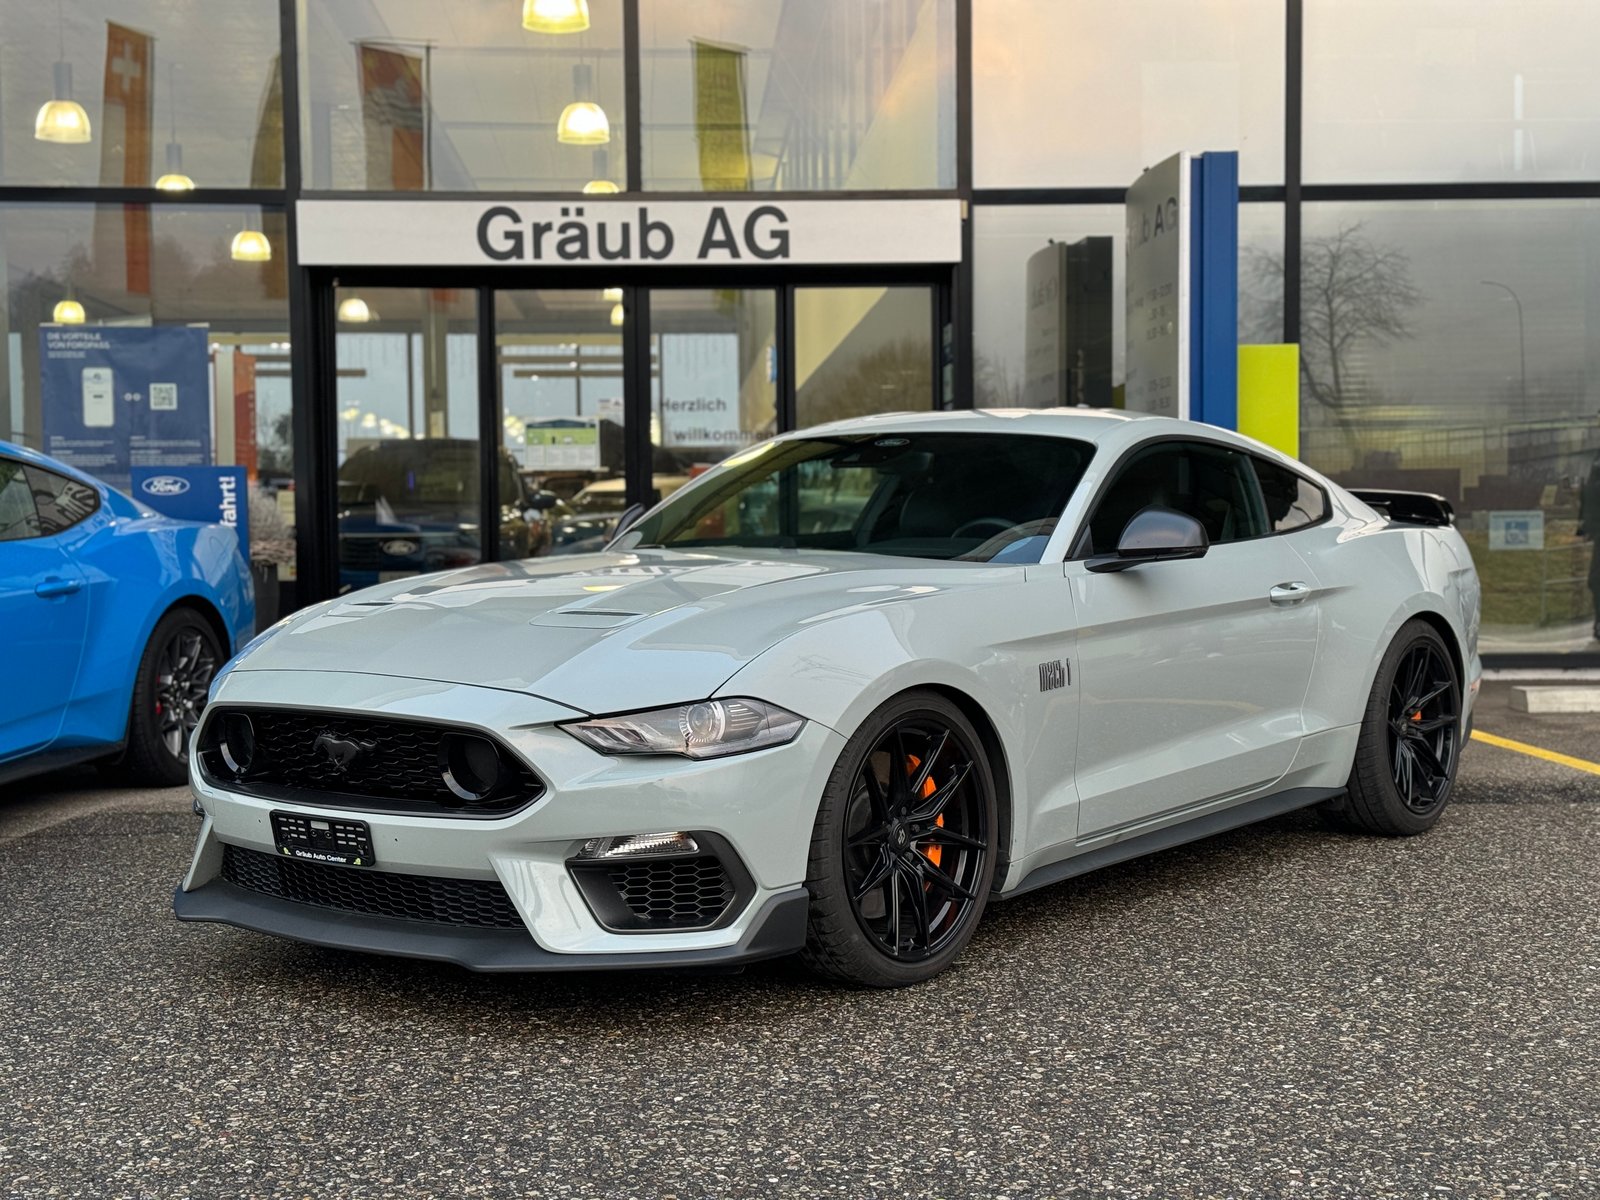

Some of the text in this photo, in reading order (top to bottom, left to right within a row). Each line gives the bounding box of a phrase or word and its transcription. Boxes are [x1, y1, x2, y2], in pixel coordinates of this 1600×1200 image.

[477, 205, 790, 261] Gräub AG
[148, 478, 183, 494] Ford
[327, 855, 346, 863] Center
